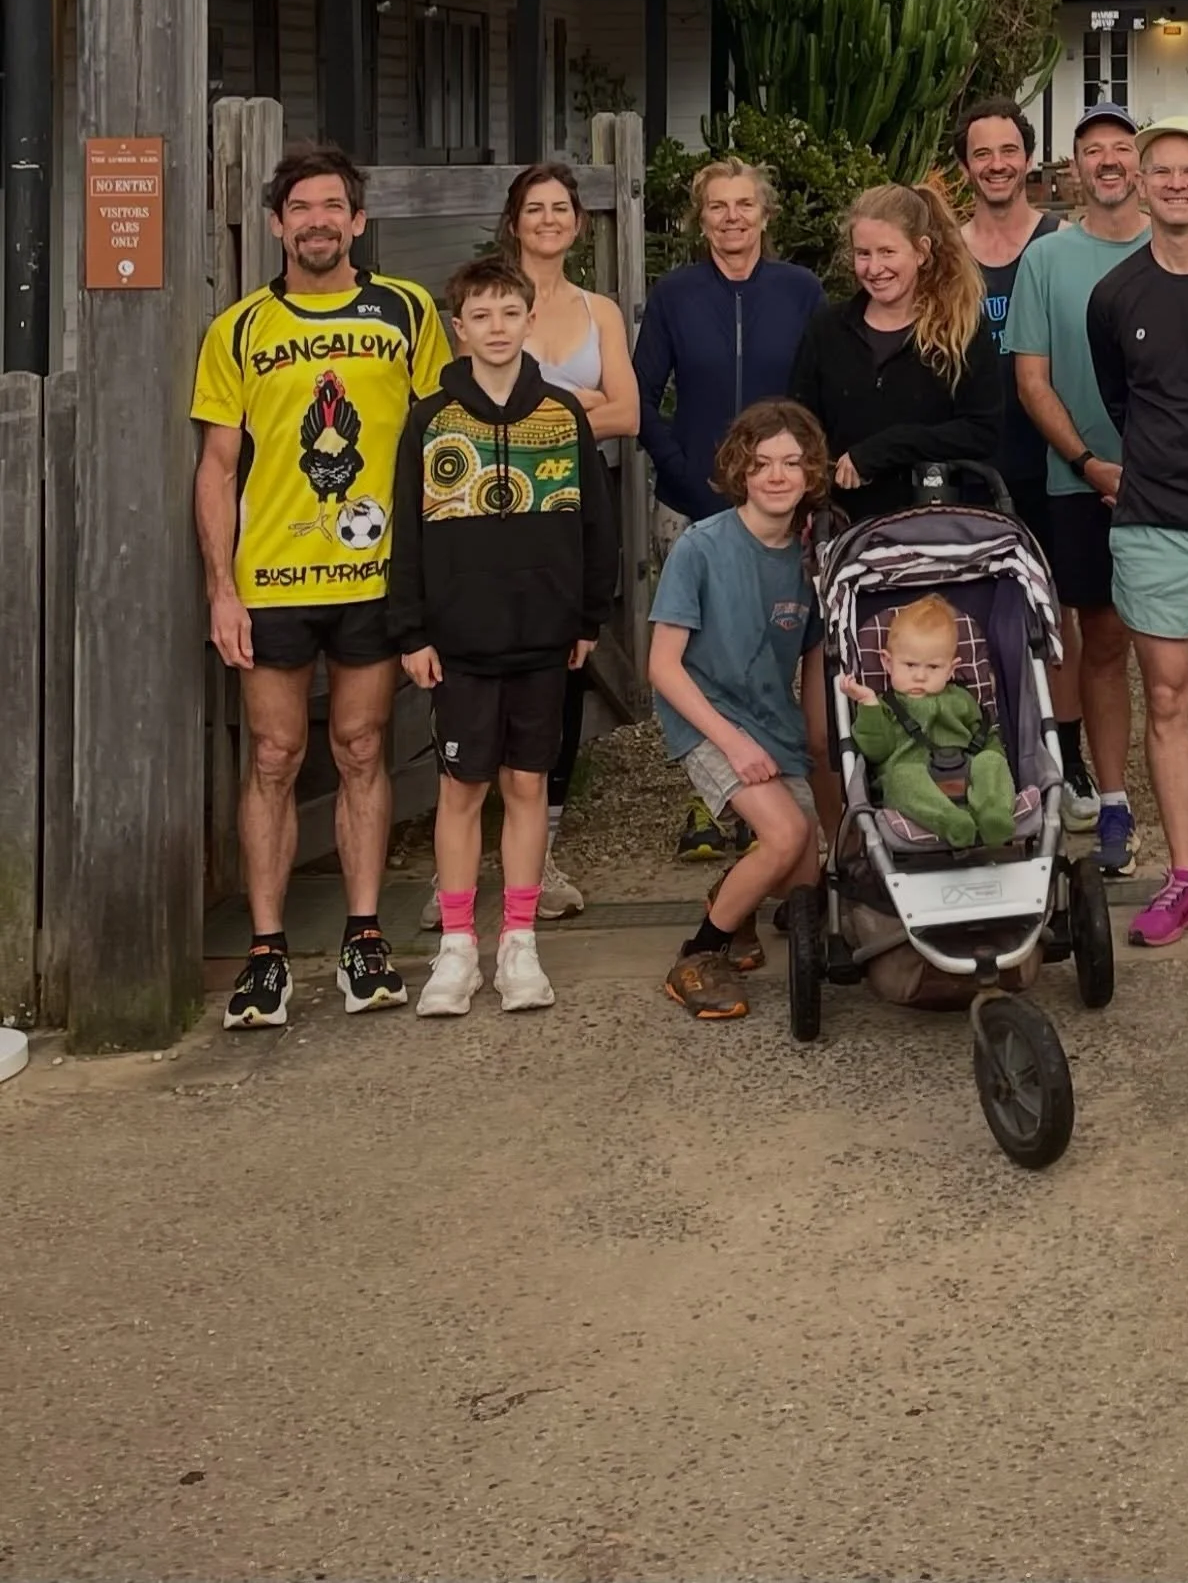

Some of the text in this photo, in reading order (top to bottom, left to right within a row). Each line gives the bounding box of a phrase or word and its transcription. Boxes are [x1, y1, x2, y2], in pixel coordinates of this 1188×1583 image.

[96, 180, 154, 192] NO ENTRY
[99, 207, 149, 218] VISITORS
[111, 221, 140, 233] CARS
[111, 236, 139, 248] ONLY
[251, 333, 402, 377] BANGALOW
[254, 566, 307, 587] BUSH
